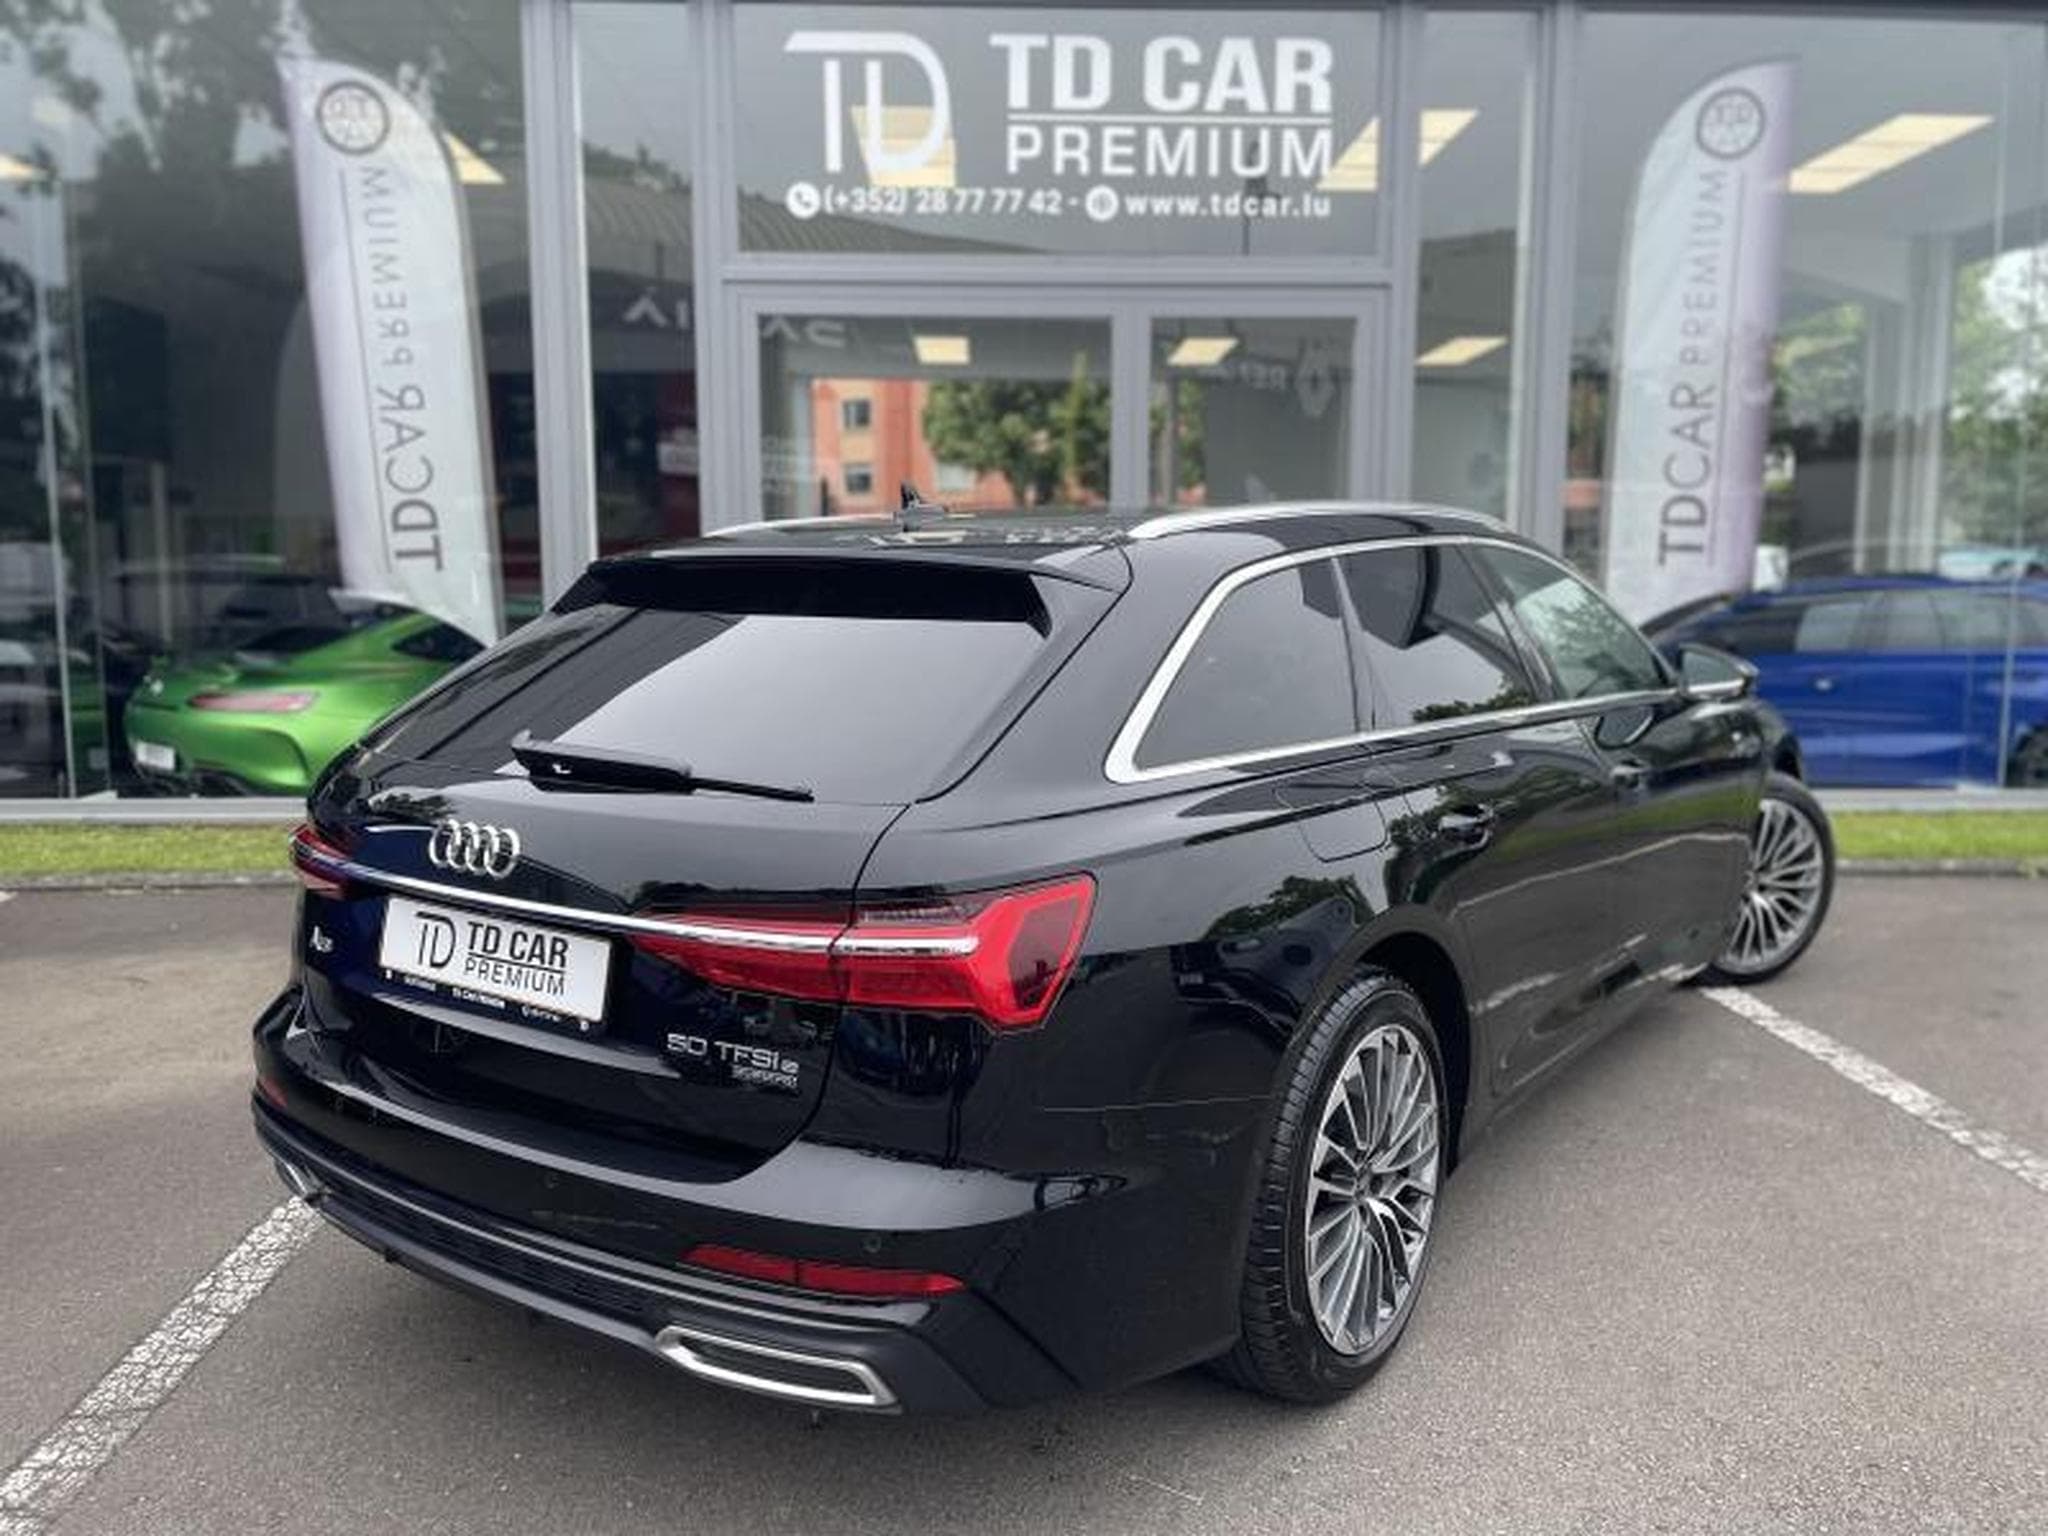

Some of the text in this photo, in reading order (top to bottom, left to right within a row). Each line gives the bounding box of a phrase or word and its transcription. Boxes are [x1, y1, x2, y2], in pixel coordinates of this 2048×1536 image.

[990, 33, 1333, 112] TD CAR
[1007, 126, 1333, 177] PREMIUM
[823, 186, 909, 214] (+352)
[916, 187, 946, 214] 28
[952, 188, 985, 213] 77
[992, 188, 1026, 213] 77
[1028, 189, 1063, 214] 42
[1125, 192, 1331, 217] www.tdcar.lu
[1680, 169, 1727, 368] PREMIUM
[467, 921, 569, 969] TD CAR
[463, 960, 567, 997] PREMIUM
[667, 1033, 708, 1056] 50
[714, 1041, 779, 1070] TFSI
